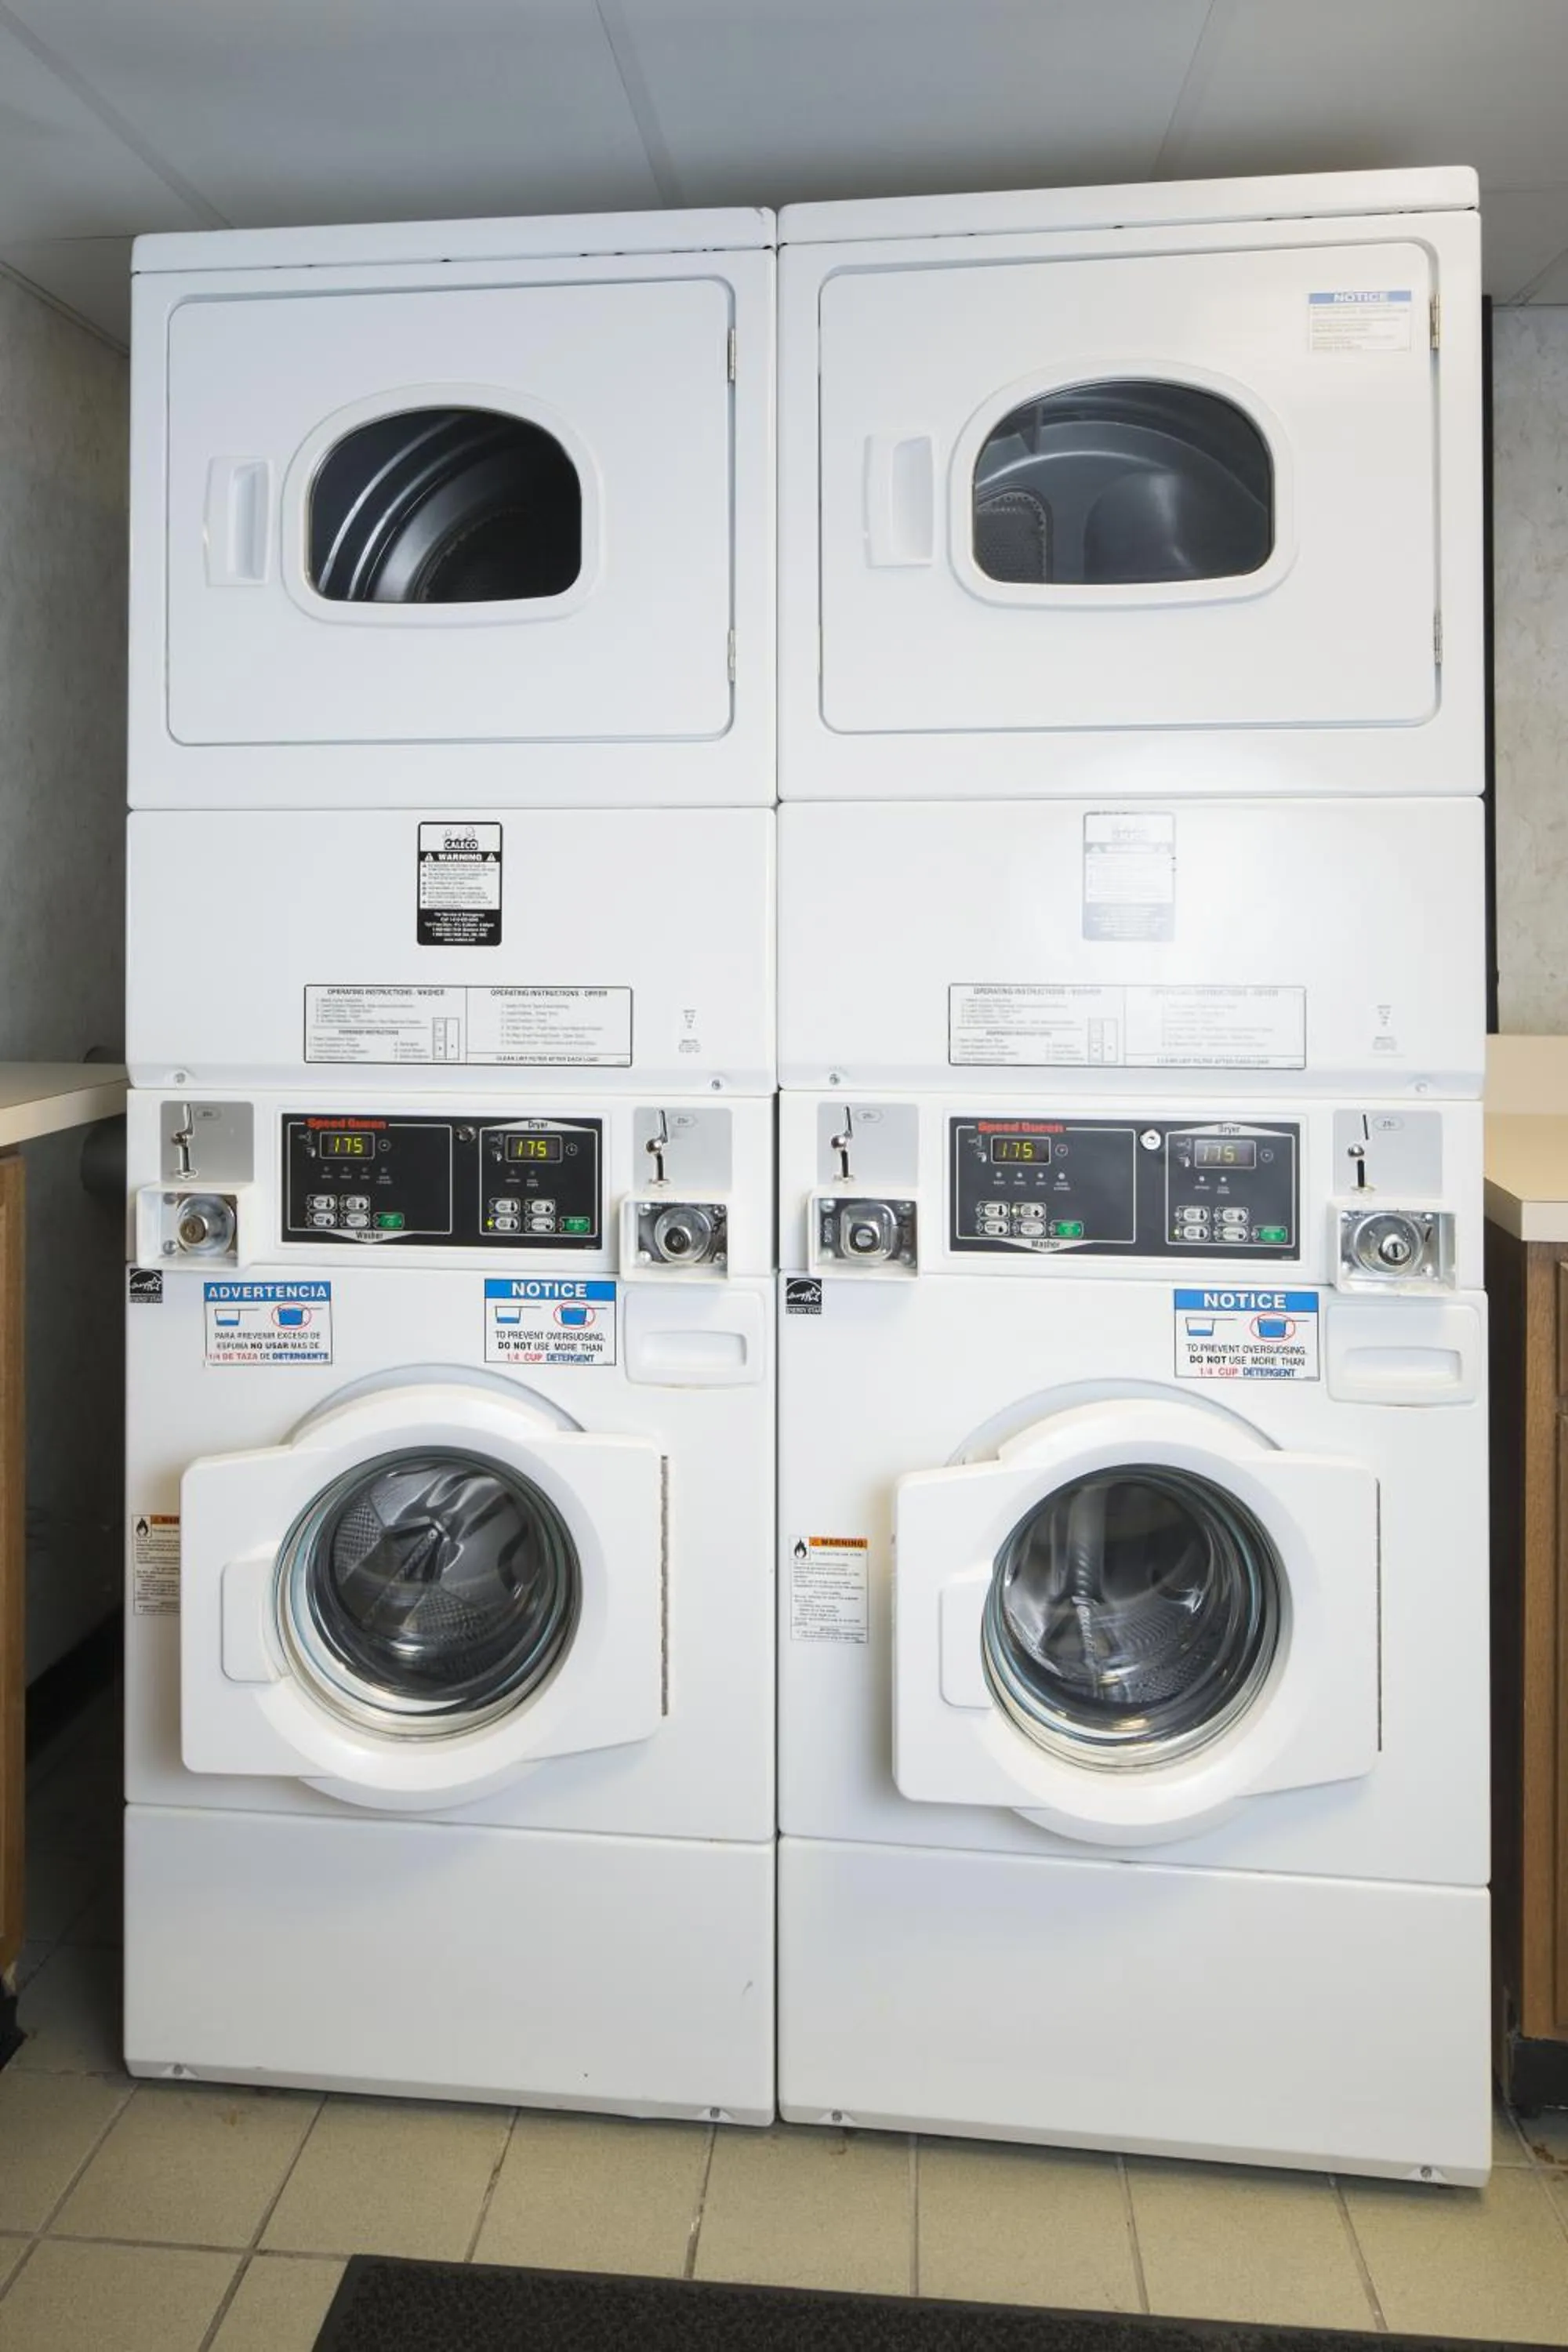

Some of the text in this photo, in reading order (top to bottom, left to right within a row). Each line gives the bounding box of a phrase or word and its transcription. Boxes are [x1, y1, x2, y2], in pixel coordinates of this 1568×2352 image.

[307, 1119, 346, 1129] Speed
[978, 1122, 1018, 1133] Speed
[335, 1138, 363, 1153] 175
[517, 1142, 546, 1156] 175
[1002, 1142, 1033, 1158] 175
[208, 1286, 327, 1298] ADVERTENCIA
[512, 1282, 586, 1298] NOTICE
[1203, 1293, 1287, 1308] NOTICE
[495, 1331, 506, 1340] TO
[507, 1331, 543, 1340] PREVENT
[1187, 1343, 1198, 1352] TO
[1200, 1344, 1240, 1353] PREVENT
[546, 1354, 594, 1363] DETERGENT
[1251, 1356, 1277, 1365] MORE
[1282, 1357, 1305, 1366] THAN
[1218, 1367, 1238, 1376] CUP
[1243, 1368, 1296, 1377] DETERGENT
